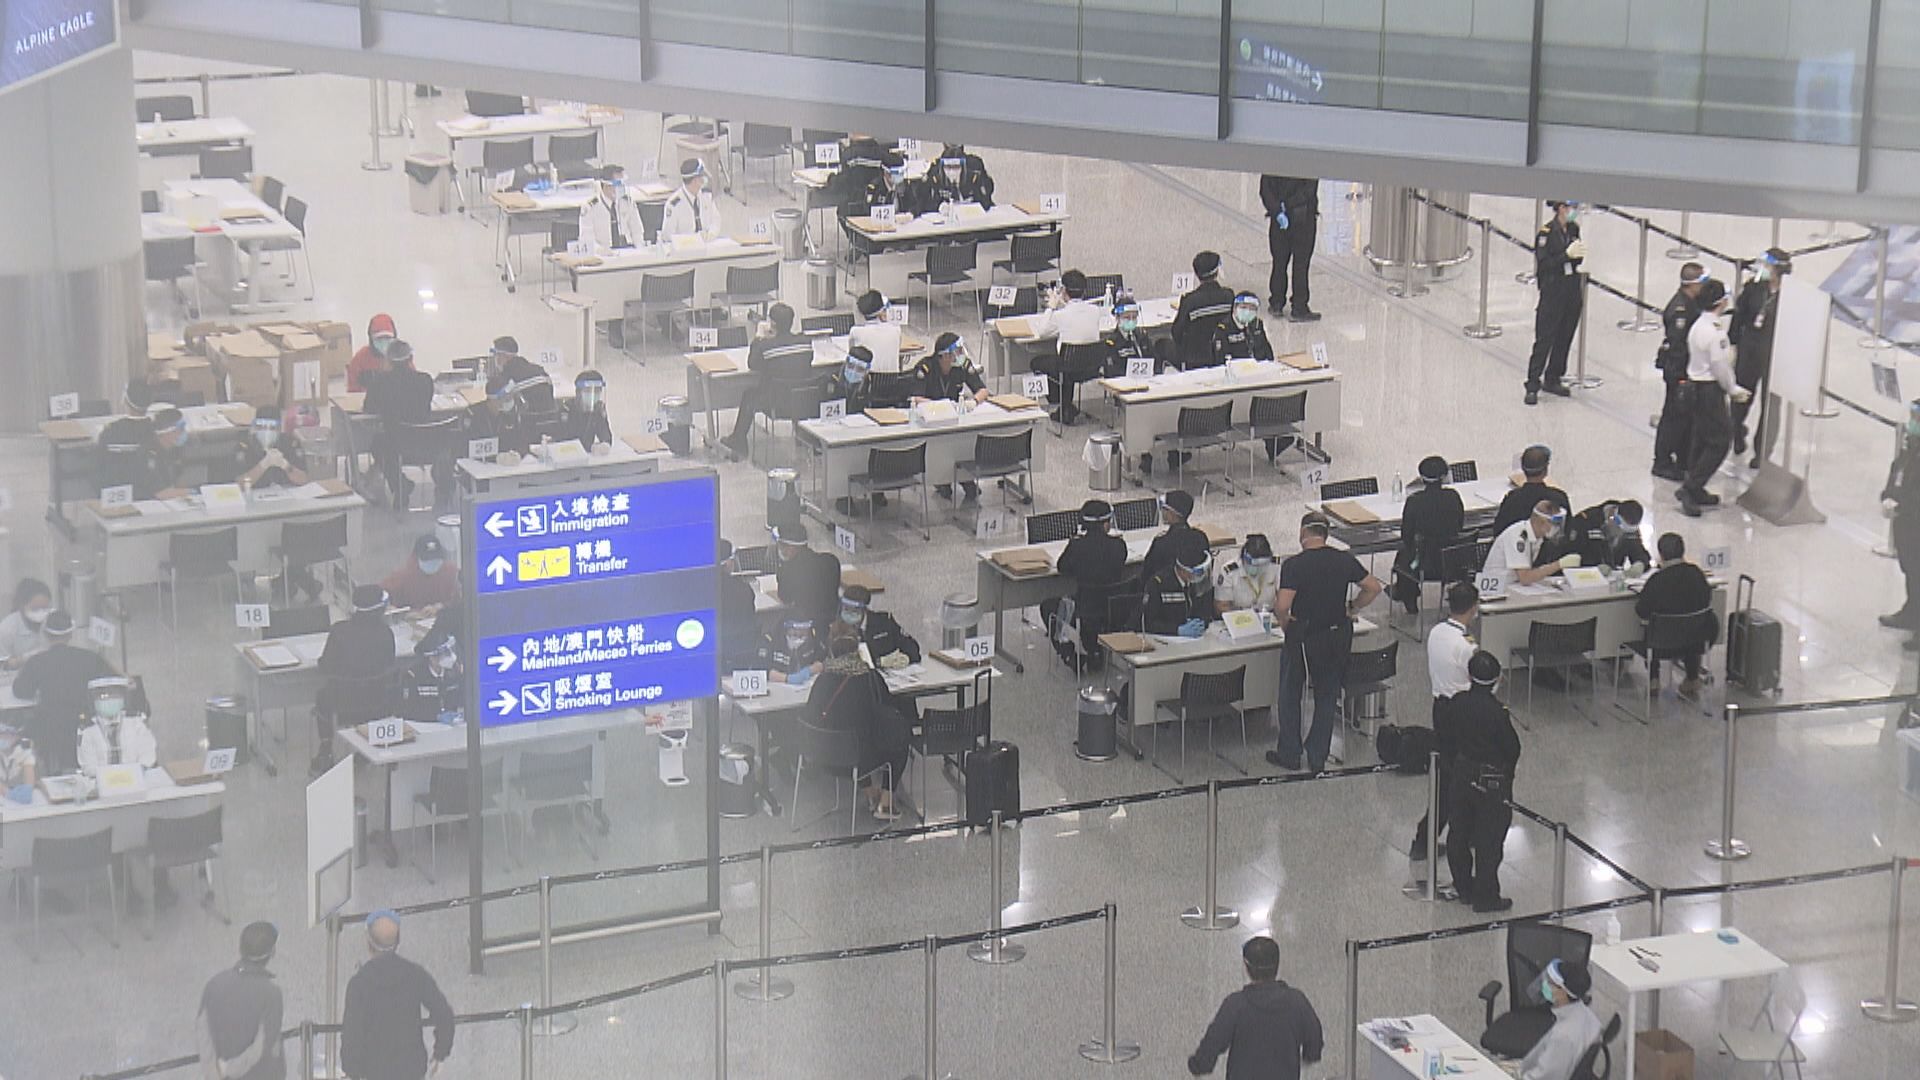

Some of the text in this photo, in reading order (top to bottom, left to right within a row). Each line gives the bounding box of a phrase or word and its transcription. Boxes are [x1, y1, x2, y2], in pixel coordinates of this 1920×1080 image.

[16, 11, 95, 55] ALPINE EAGLE
[821, 147, 833, 158] 47
[1046, 198, 1060, 209] 41
[875, 208, 889, 220] 42
[754, 222, 767, 234] 43
[1177, 277, 1188, 288] 31
[995, 288, 1011, 299] 32
[695, 332, 710, 343] 34
[1132, 362, 1148, 374] 22
[1028, 381, 1043, 394] 23
[826, 405, 841, 418] 24
[647, 418, 662, 433] 25
[475, 441, 492, 454] 26
[1307, 470, 1322, 485] 12
[551, 512, 629, 534] Immigration
[983, 519, 996, 532] 14
[839, 532, 851, 548] 15
[1707, 551, 1723, 566] 01
[575, 556, 628, 576] Transfer
[1480, 578, 1498, 591] 02
[245, 607, 263, 622] 18
[522, 640, 673, 672] Mainland/Macao Ferries
[970, 643, 988, 656] 05
[740, 675, 760, 690] 06
[555, 686, 663, 711] Smoking Lounge
[376, 723, 395, 739] 08
